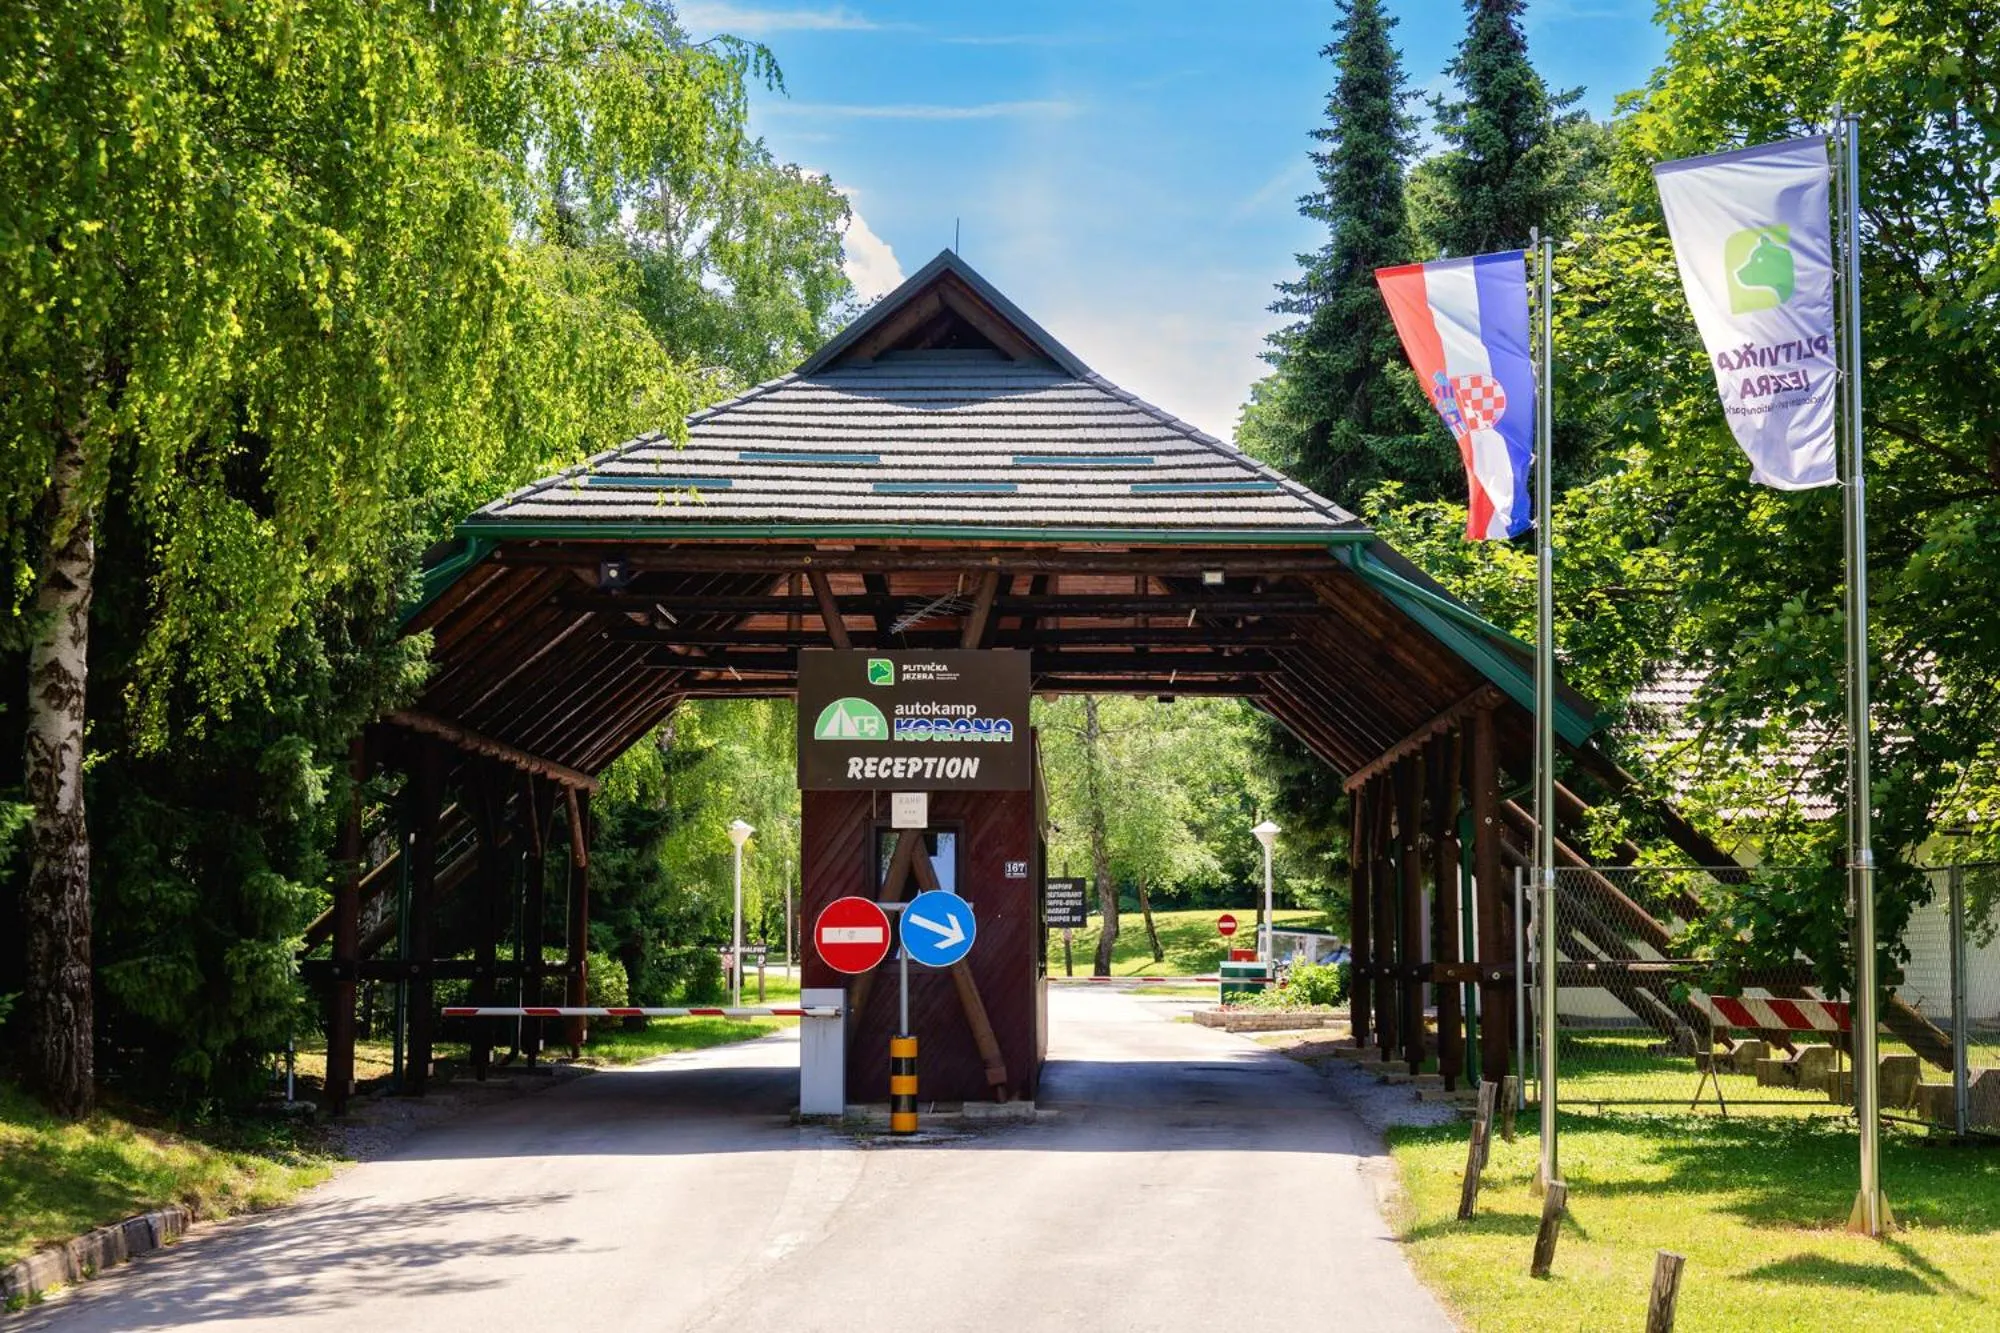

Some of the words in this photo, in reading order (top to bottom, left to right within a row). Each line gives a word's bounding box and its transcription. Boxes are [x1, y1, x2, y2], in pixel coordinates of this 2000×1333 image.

[902, 662, 948, 672] PLITVIČKA
[902, 673, 935, 682] JEZERA
[895, 702, 977, 718] autokamp
[894, 717, 1013, 742] KORANA
[847, 756, 980, 780] RECEPTION
[1006, 863, 1025, 873] 167
